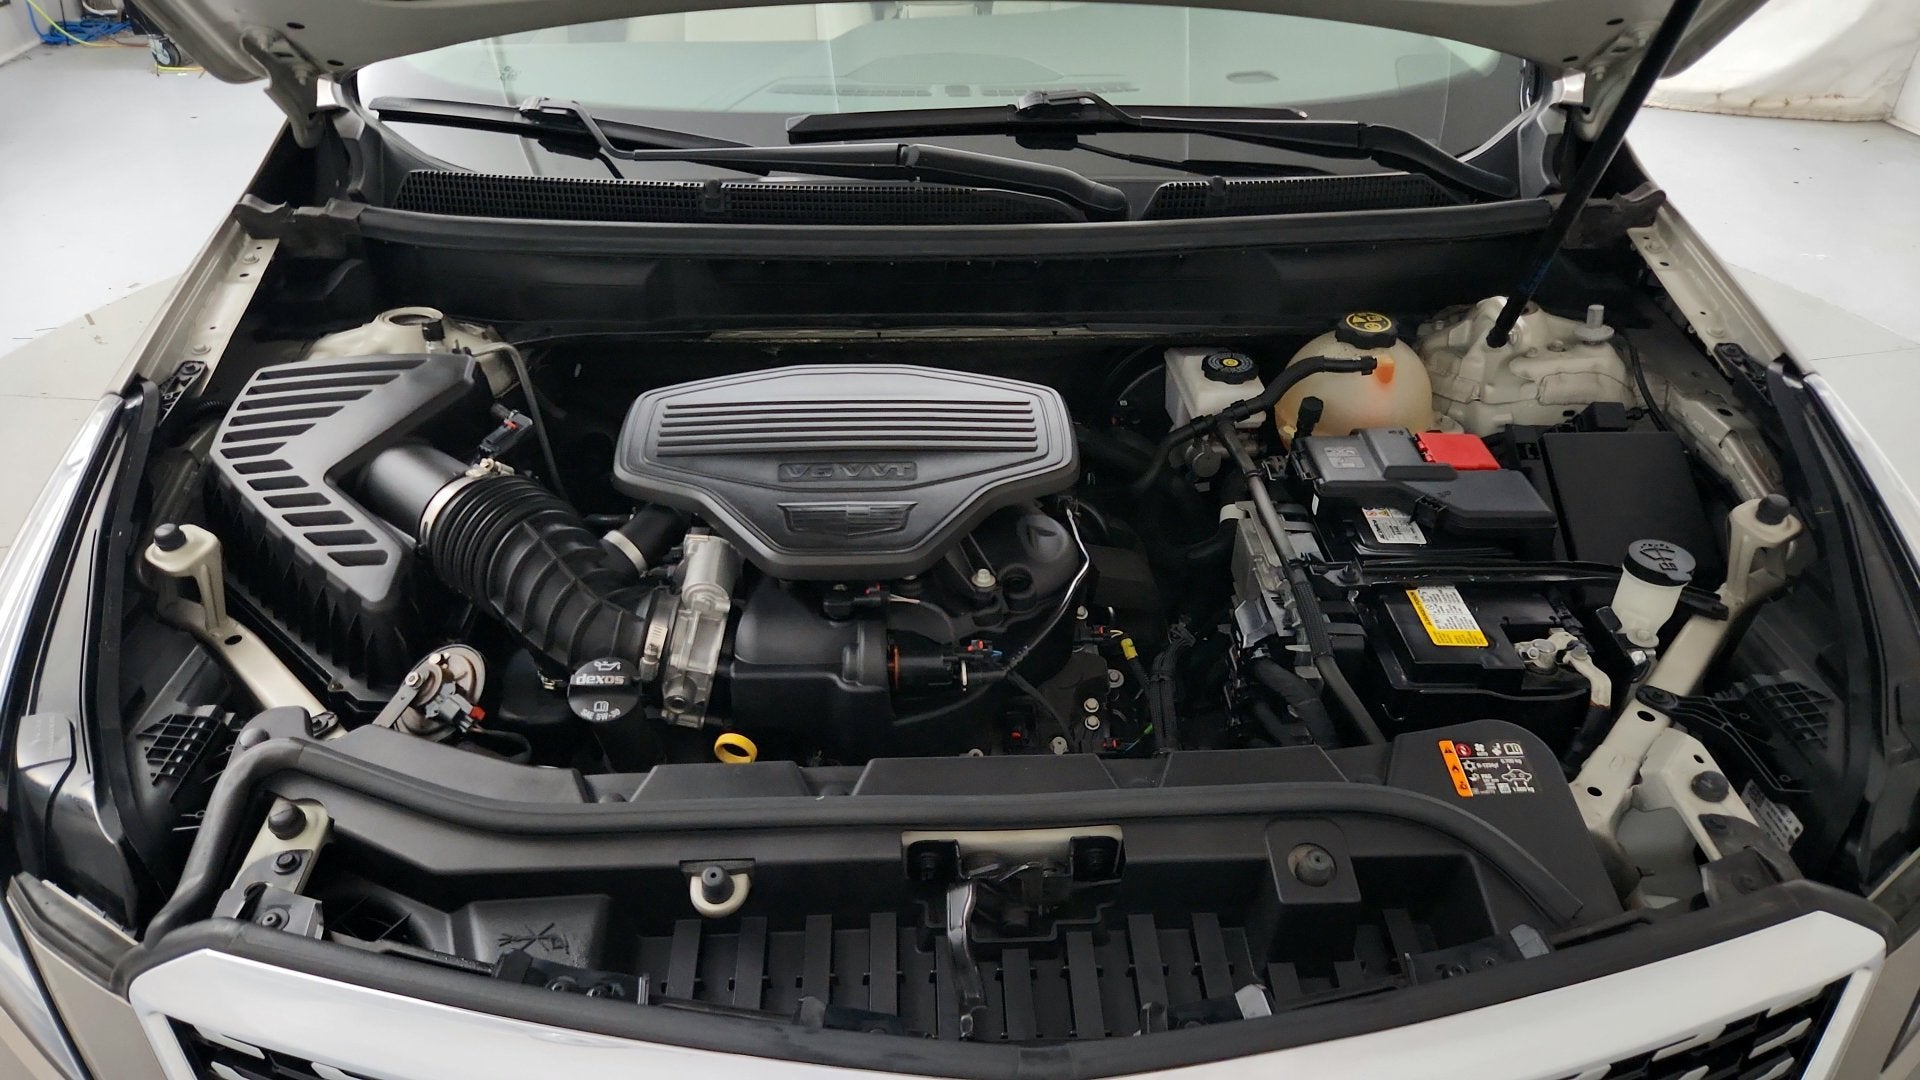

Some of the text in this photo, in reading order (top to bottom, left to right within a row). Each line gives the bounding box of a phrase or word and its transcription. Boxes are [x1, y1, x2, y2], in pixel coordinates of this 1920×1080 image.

[785, 464, 911, 477] V6 VVT
[576, 674, 624, 685] dexos
[580, 708, 595, 720] SAE
